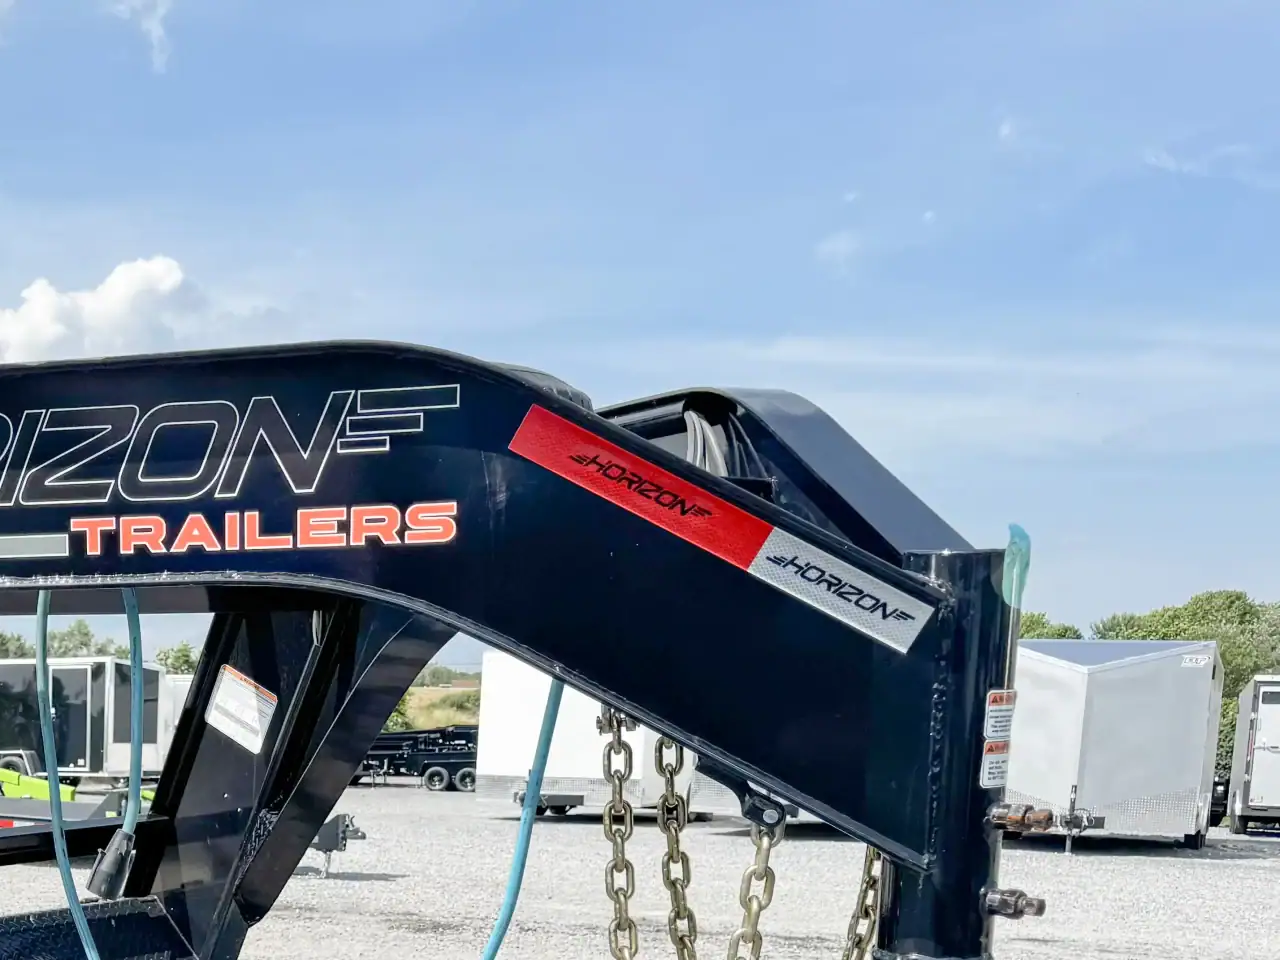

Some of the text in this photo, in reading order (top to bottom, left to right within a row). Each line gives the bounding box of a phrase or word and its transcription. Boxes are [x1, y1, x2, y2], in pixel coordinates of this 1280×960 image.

[582, 454, 698, 517] HORIZON
[70, 502, 459, 557] TRAILERS
[781, 555, 900, 621] HORIZON
